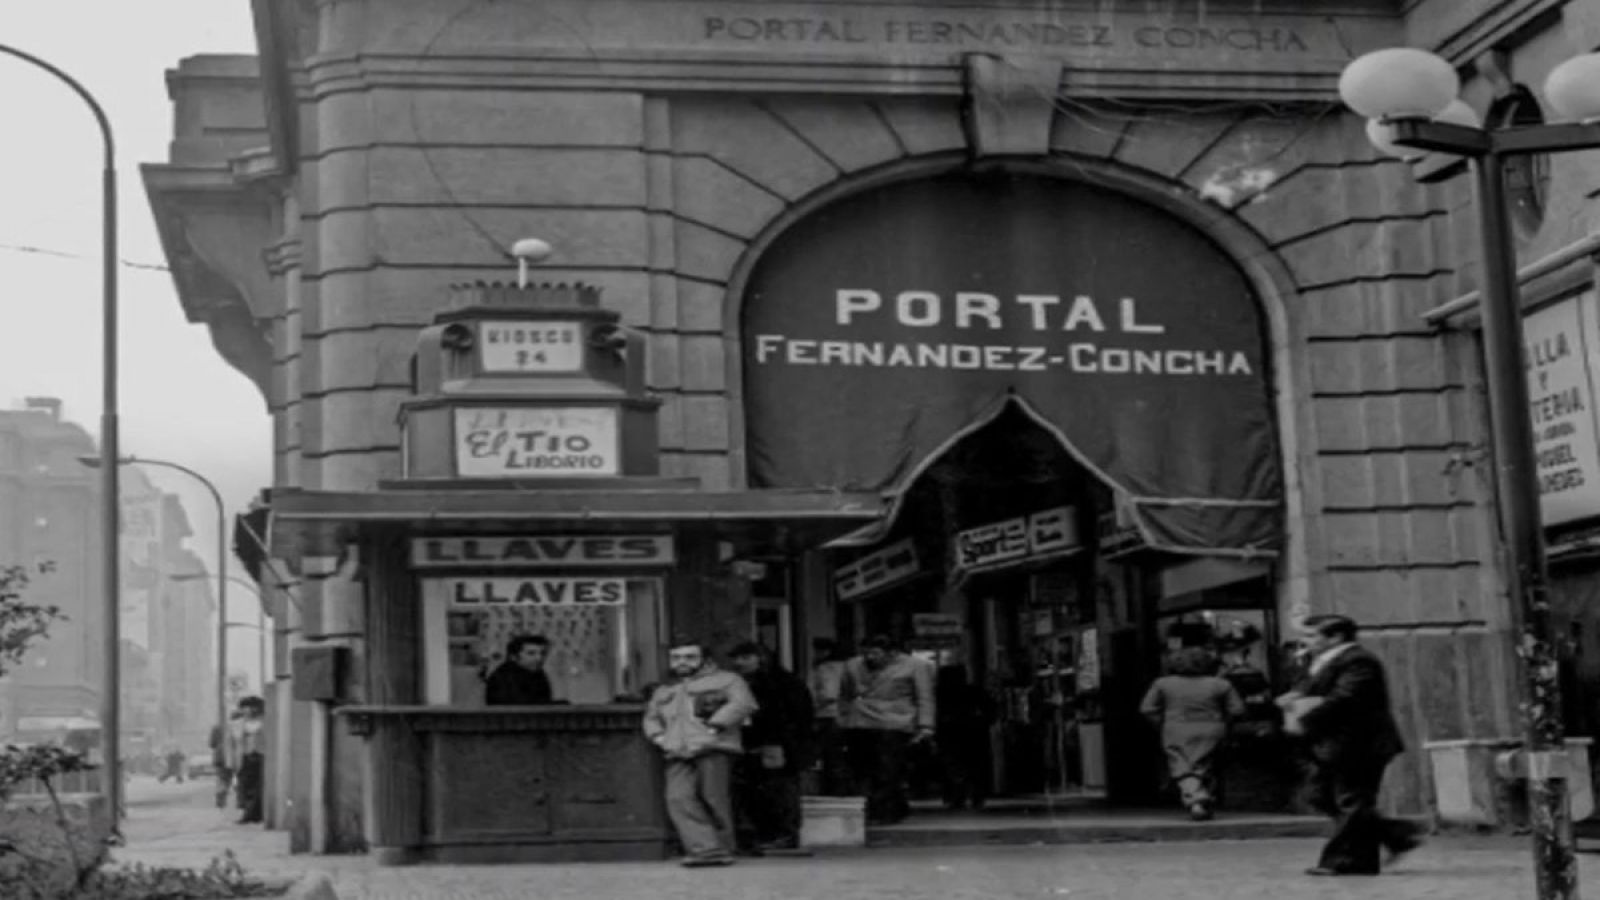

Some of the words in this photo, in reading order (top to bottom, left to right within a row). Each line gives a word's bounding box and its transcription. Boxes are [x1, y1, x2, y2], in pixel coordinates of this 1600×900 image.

[704, 16, 867, 43] PORTAL
[885, 20, 1113, 48] FERNANDEZ
[1134, 25, 1309, 52] CONCHA
[836, 288, 1165, 334] PORTAL
[1529, 331, 1571, 369] LLA
[464, 429, 510, 459] El
[515, 430, 593, 452] TIO
[504, 449, 605, 470] LIBORIO
[426, 537, 660, 562] LLAVES
[455, 581, 622, 604] LLAVES
